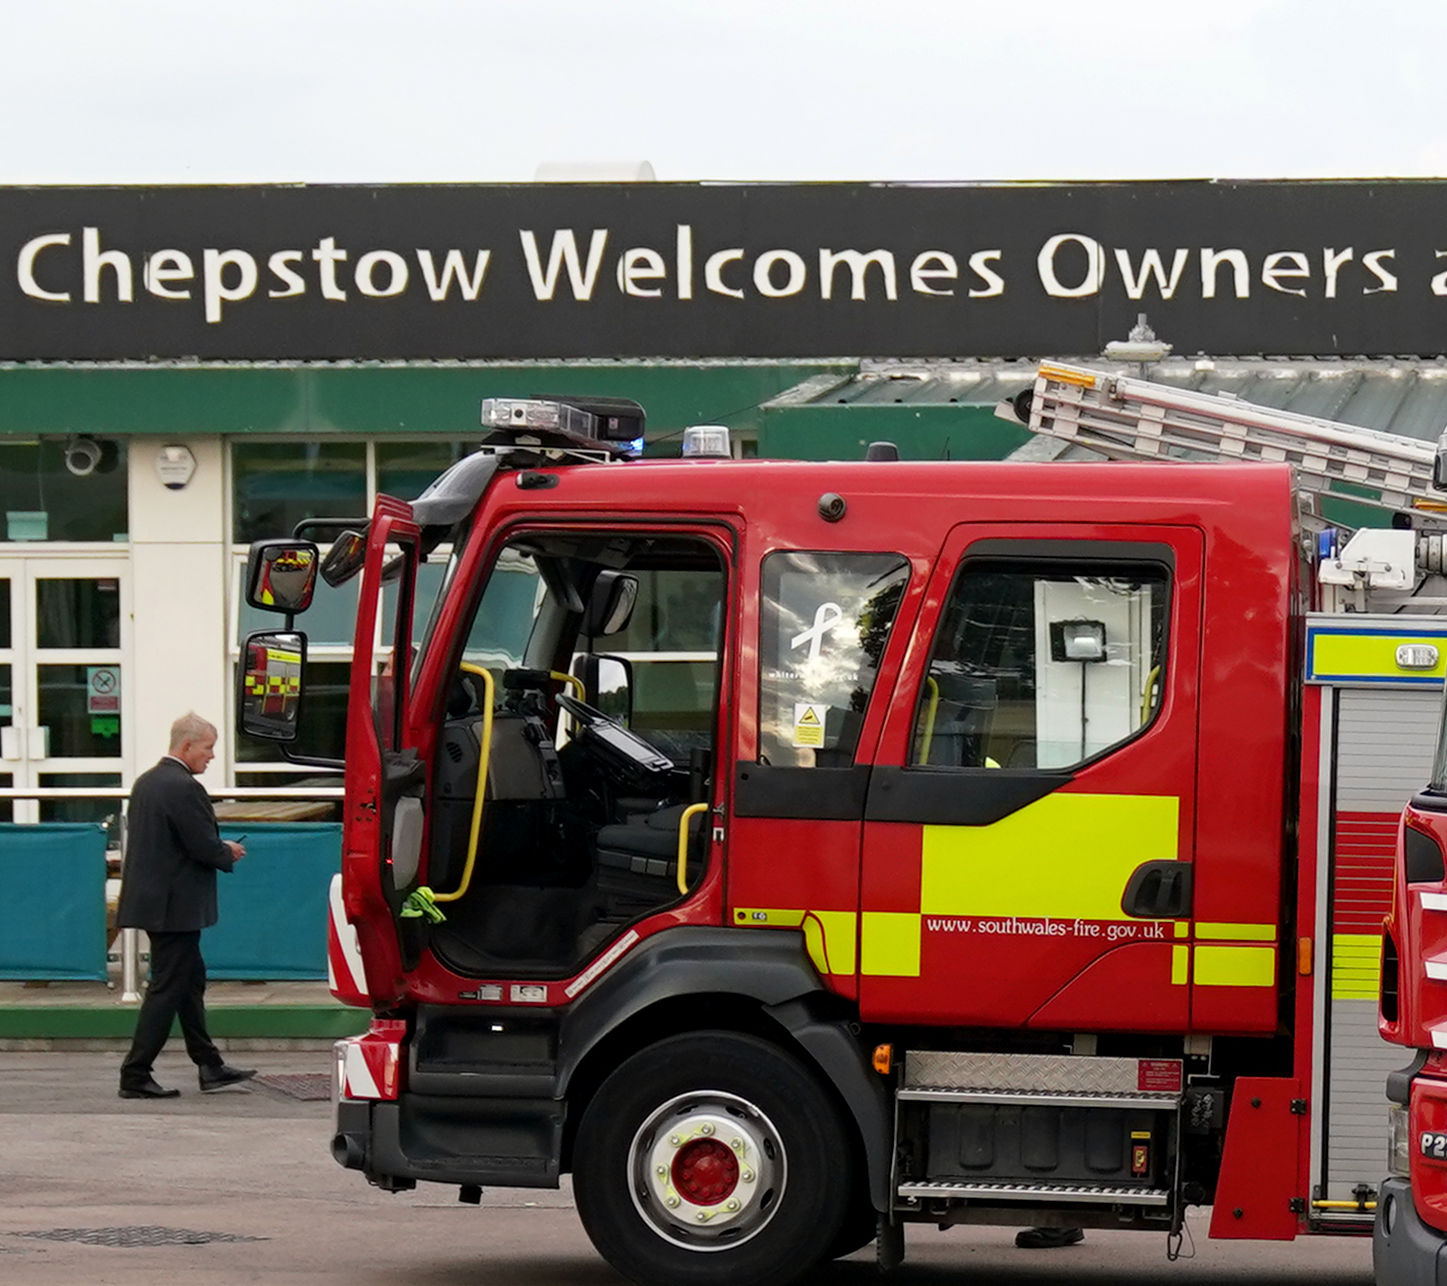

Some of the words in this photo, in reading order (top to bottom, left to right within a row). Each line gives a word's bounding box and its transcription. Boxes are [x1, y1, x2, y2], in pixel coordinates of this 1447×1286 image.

[17, 226, 491, 324] Chepstow
[519, 224, 1005, 302] Welcomes
[1036, 232, 1399, 300] Owners
[927, 916, 1165, 941] www.southwales-fire.gov.uk
